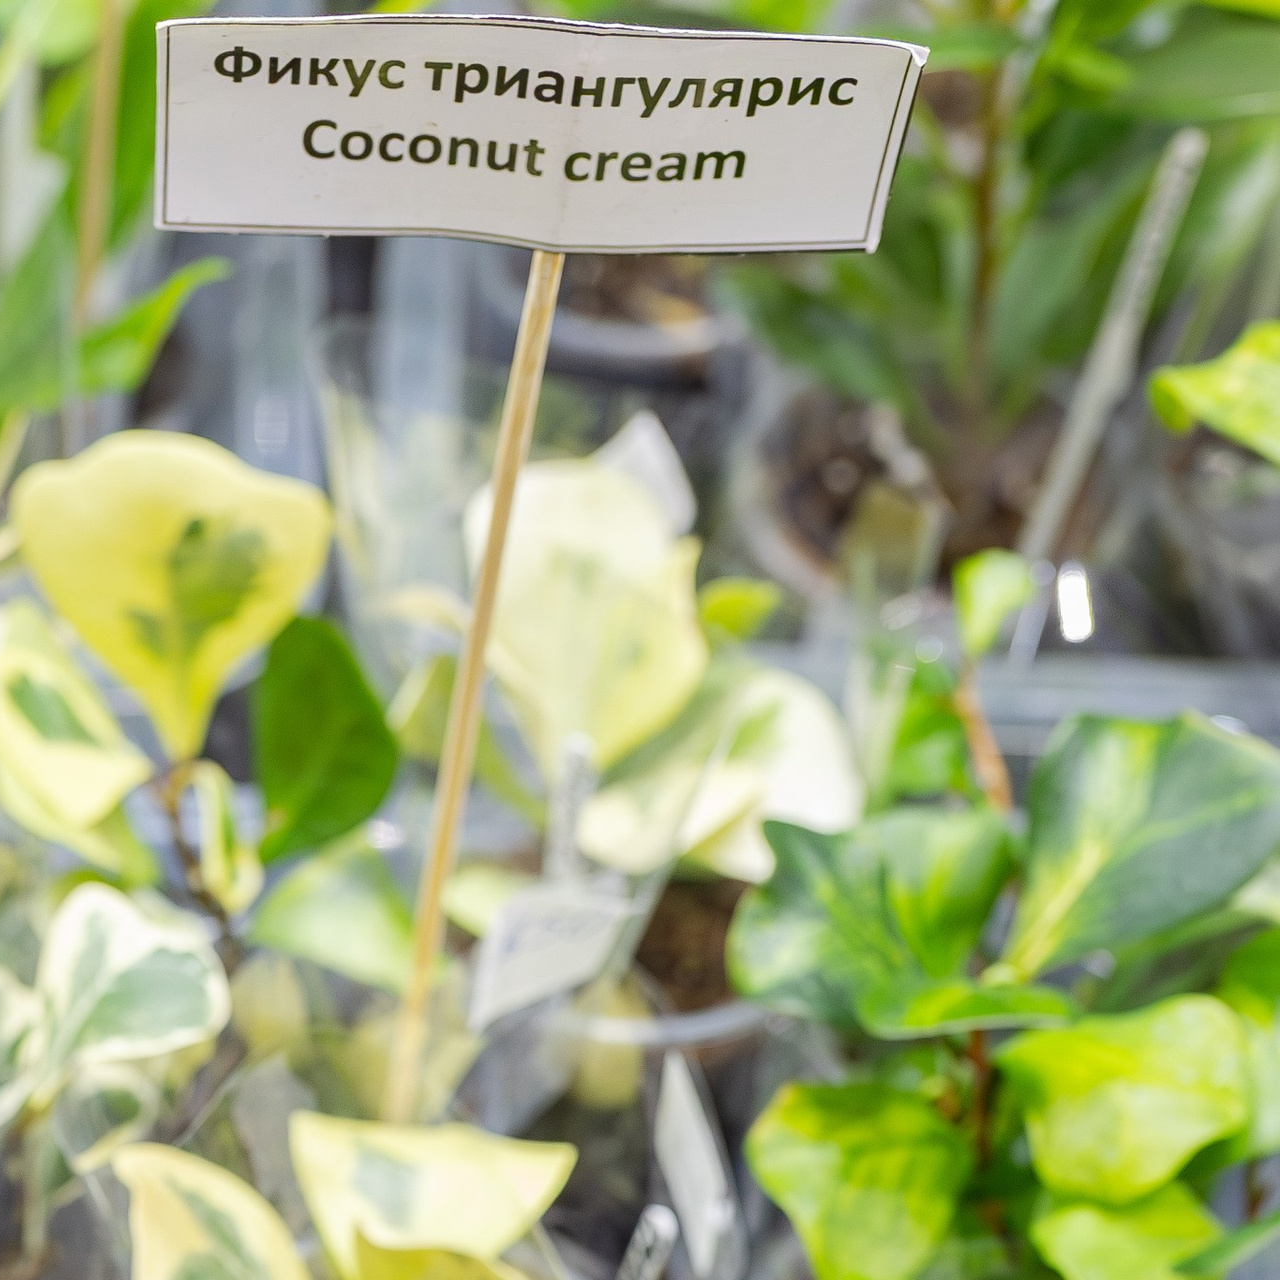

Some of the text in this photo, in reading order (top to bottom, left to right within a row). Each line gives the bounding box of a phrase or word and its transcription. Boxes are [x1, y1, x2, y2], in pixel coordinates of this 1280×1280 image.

[213, 45, 859, 119] Фикус триангулярис
[302, 119, 746, 182] Coconut cream
